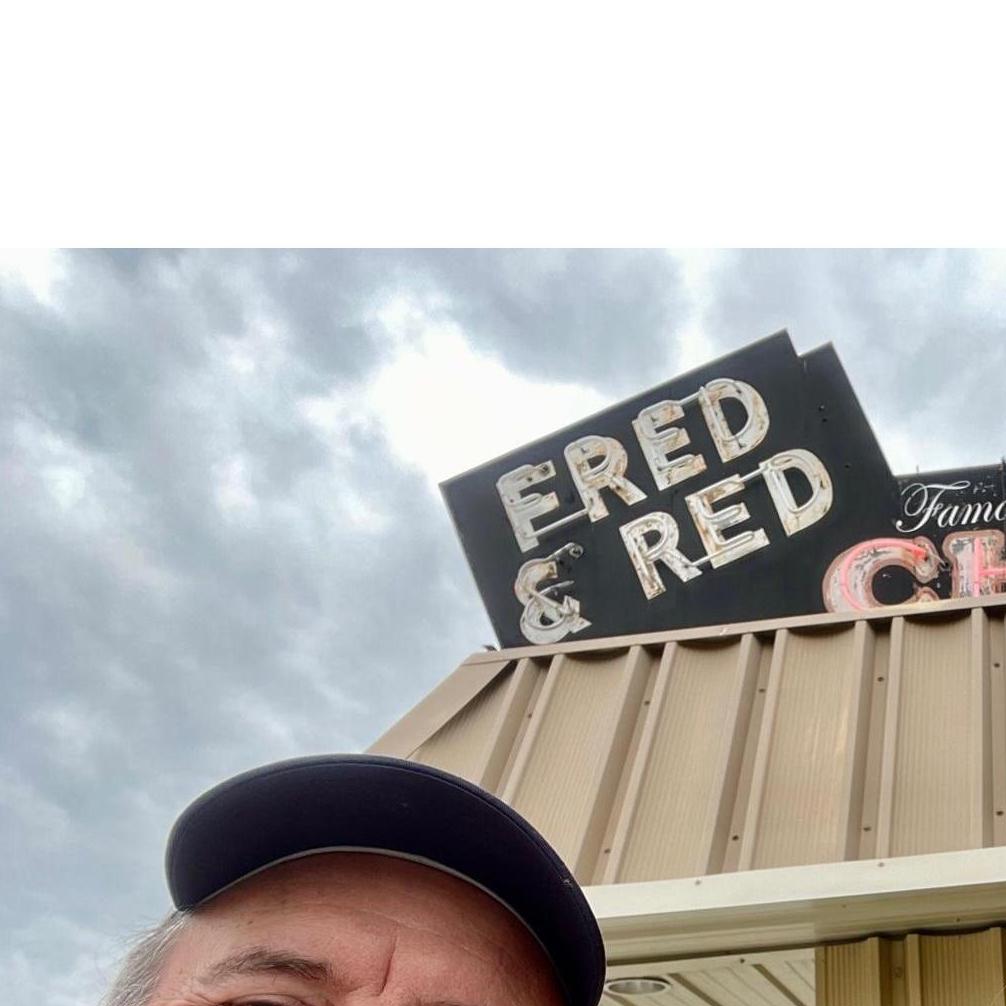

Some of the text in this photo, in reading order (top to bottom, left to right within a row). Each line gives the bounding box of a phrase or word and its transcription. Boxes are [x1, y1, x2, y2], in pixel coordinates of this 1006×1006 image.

[496, 377, 771, 553] FRED
[514, 448, 834, 645] & RED
